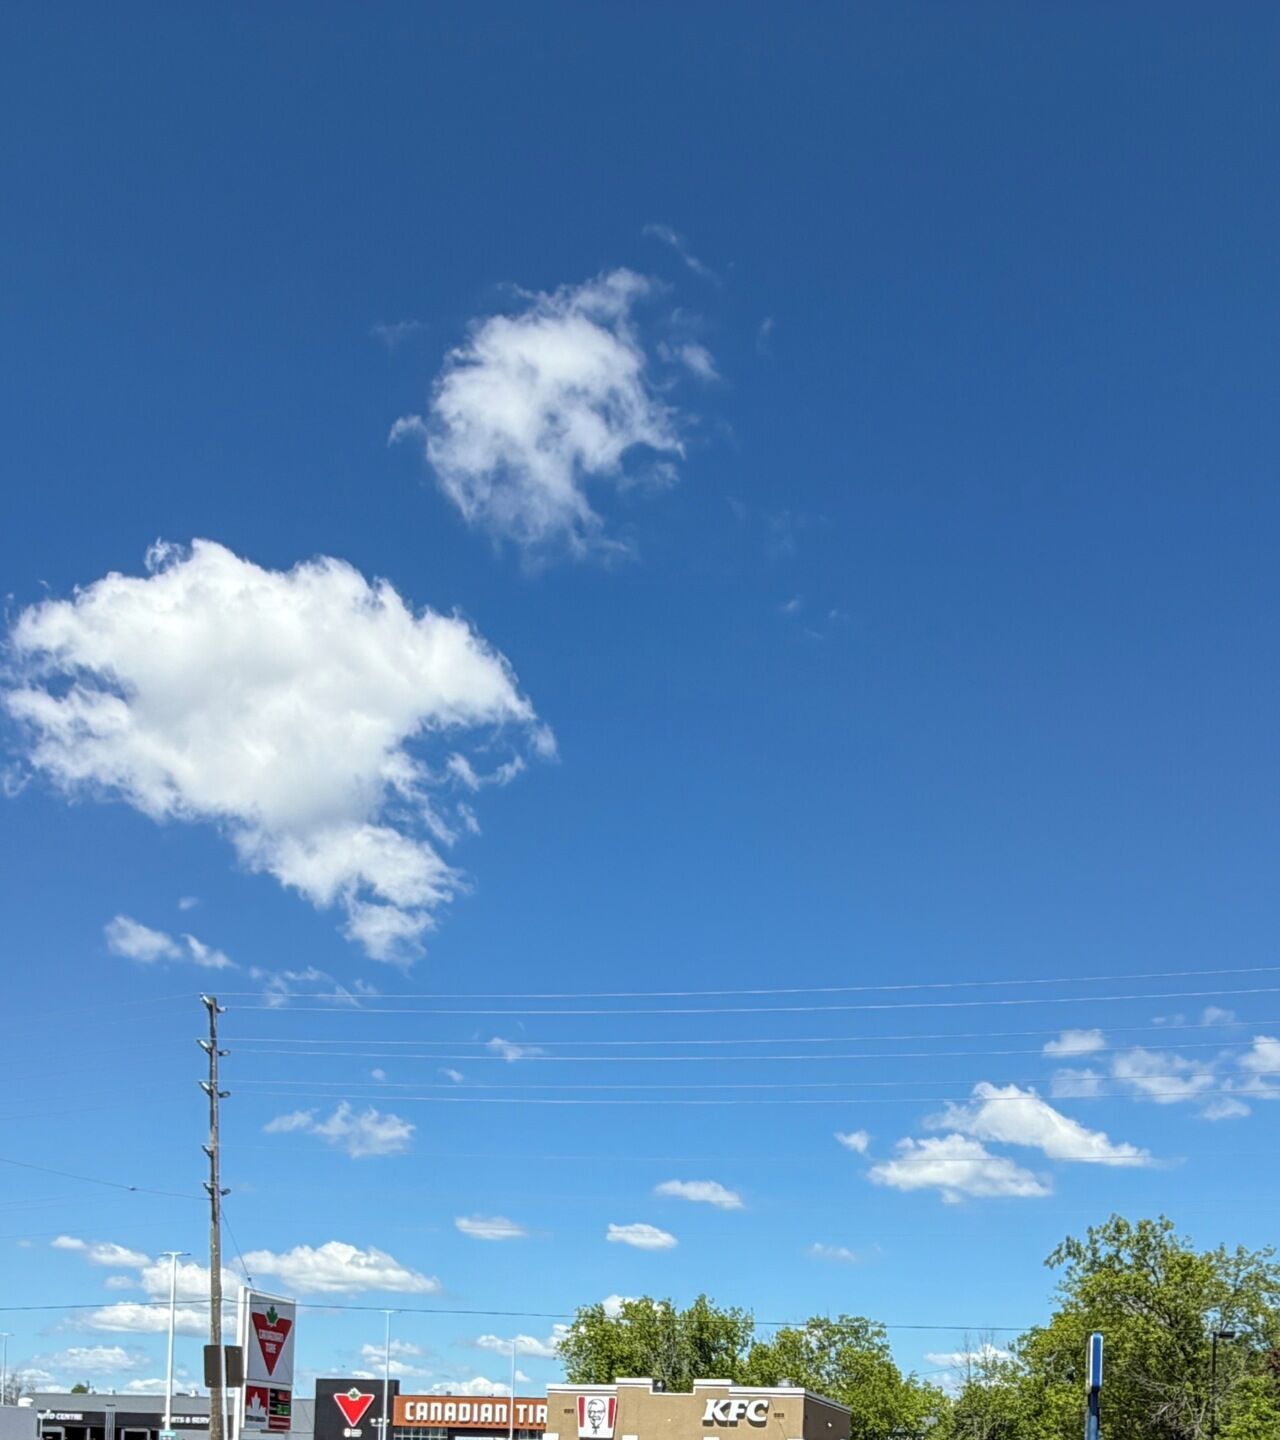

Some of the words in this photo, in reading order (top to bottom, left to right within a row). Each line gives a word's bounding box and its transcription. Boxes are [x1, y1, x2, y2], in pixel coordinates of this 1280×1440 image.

[404, 1401, 508, 1423] CANADIAN
[515, 1404, 548, 1424] TIR
[702, 1399, 768, 1422] KFC
